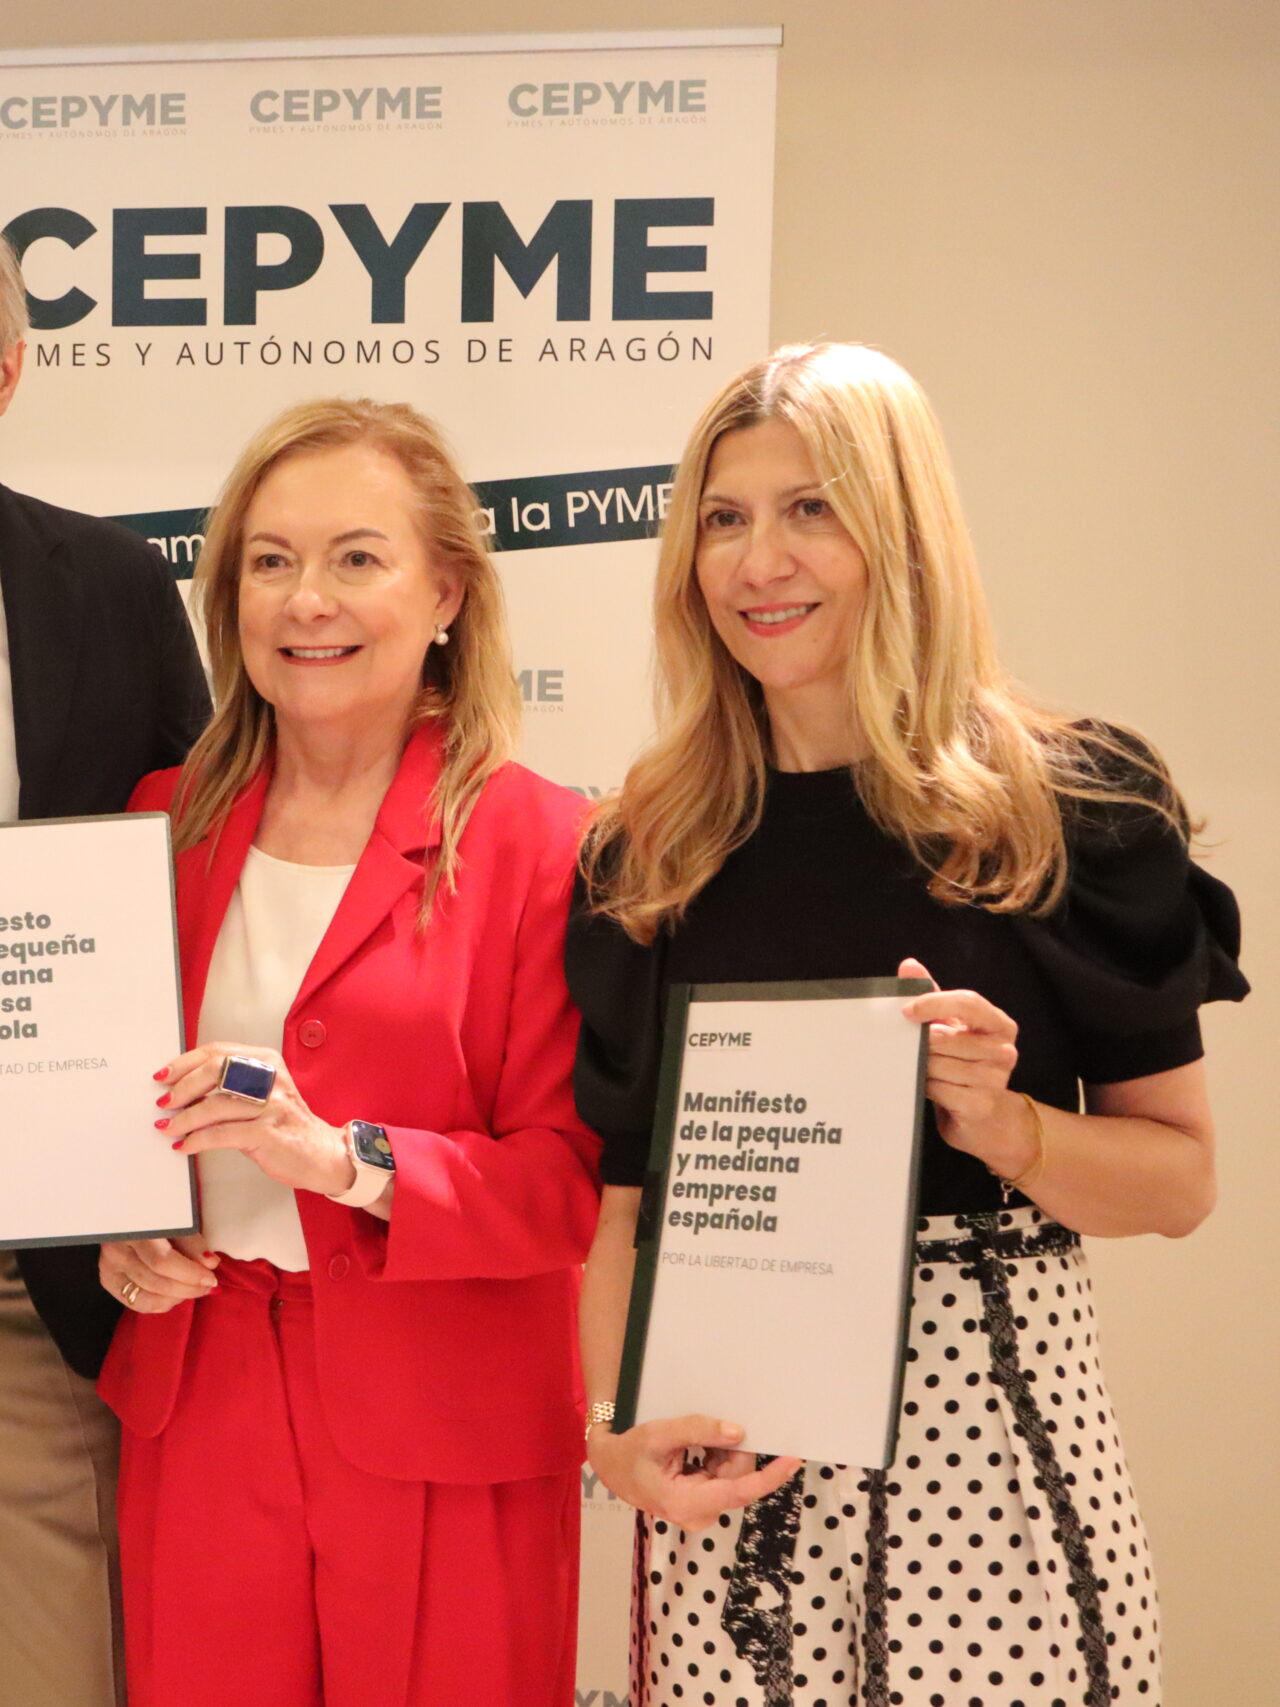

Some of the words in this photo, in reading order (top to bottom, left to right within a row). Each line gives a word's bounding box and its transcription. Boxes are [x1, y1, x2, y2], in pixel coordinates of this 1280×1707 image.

[0, 93, 186, 130] CEPYME
[250, 86, 442, 123] CEPYME
[508, 79, 706, 117] CEPYME
[3, 197, 715, 330] CEPYME
[35, 343, 111, 367] MES
[136, 343, 152, 366] Y
[176, 335, 440, 366] AUTÓNOMOS
[468, 339, 513, 363] DE
[539, 331, 712, 362] ARAGÓN
[512, 497, 551, 532] la
[688, 1032, 752, 1047] CEPYME
[28, 1061, 44, 1074] DE
[48, 1058, 108, 1072] EMPRESA
[683, 1090, 807, 1114] Manifiesto
[680, 1120, 706, 1141] de
[712, 1120, 732, 1141] la
[737, 1121, 842, 1150] pequeña
[676, 1152, 691, 1176] y
[694, 1150, 799, 1173] mediana
[672, 1181, 776, 1206] empresa
[668, 1208, 777, 1235] española
[662, 1252, 685, 1265] POR
[688, 1253, 702, 1266] LA
[705, 1254, 757, 1270] LIBERTAD
[761, 1259, 776, 1271] DE
[780, 1260, 834, 1275] EMPRESA
